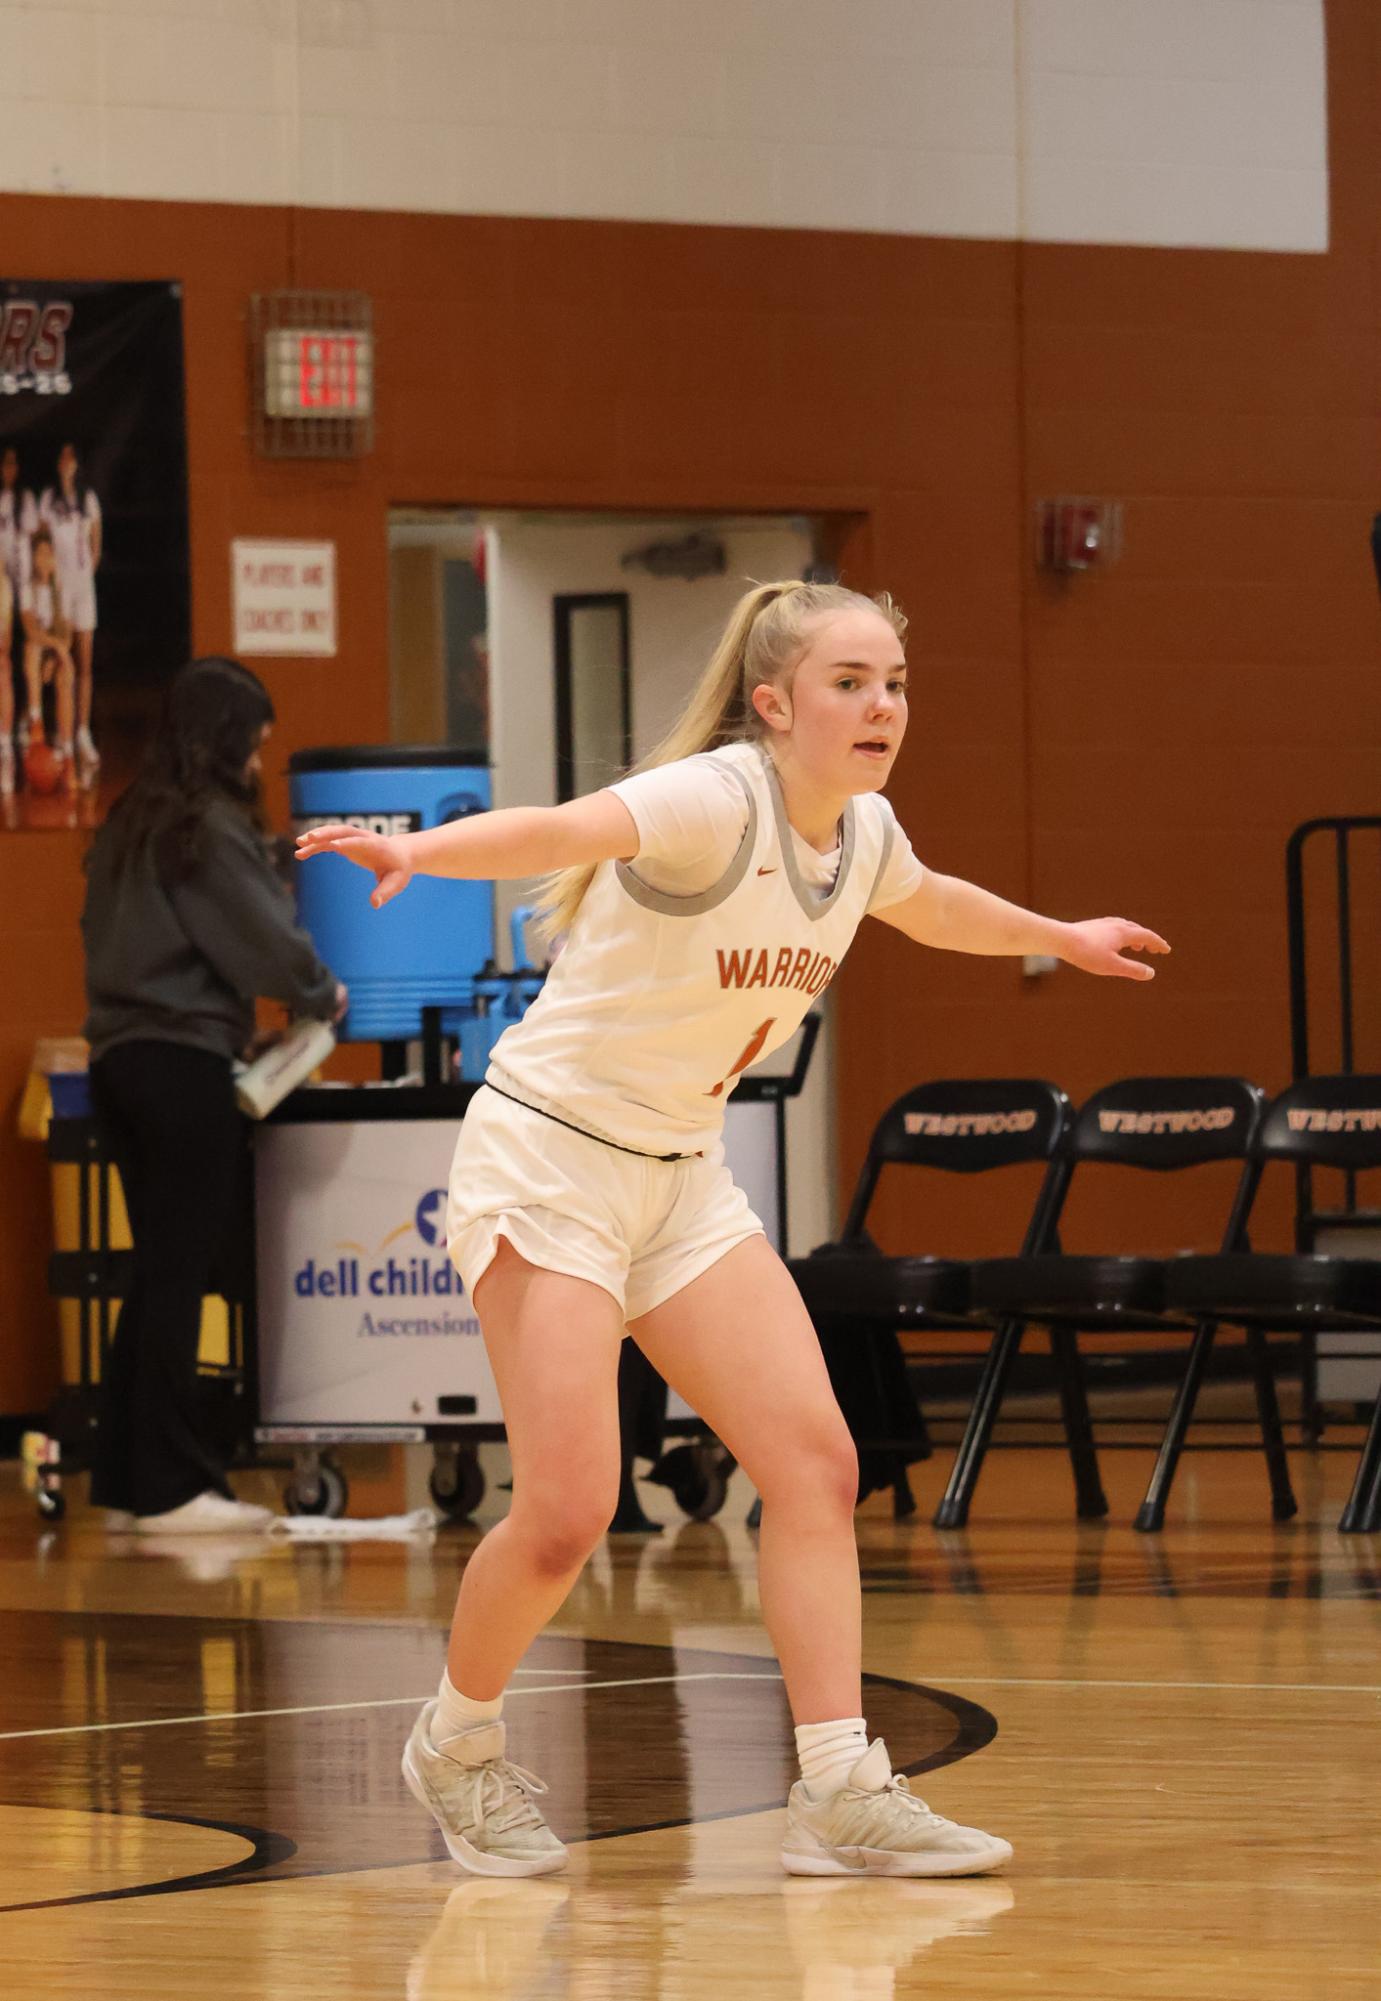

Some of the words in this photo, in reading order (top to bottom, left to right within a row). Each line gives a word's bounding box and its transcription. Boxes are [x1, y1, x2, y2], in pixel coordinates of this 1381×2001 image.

[903, 1111, 1038, 1136] WESTWOOD
[1098, 1107, 1234, 1134] WESTWOOD
[294, 1258, 358, 1297] dell
[357, 1310, 481, 1338] Ascension
